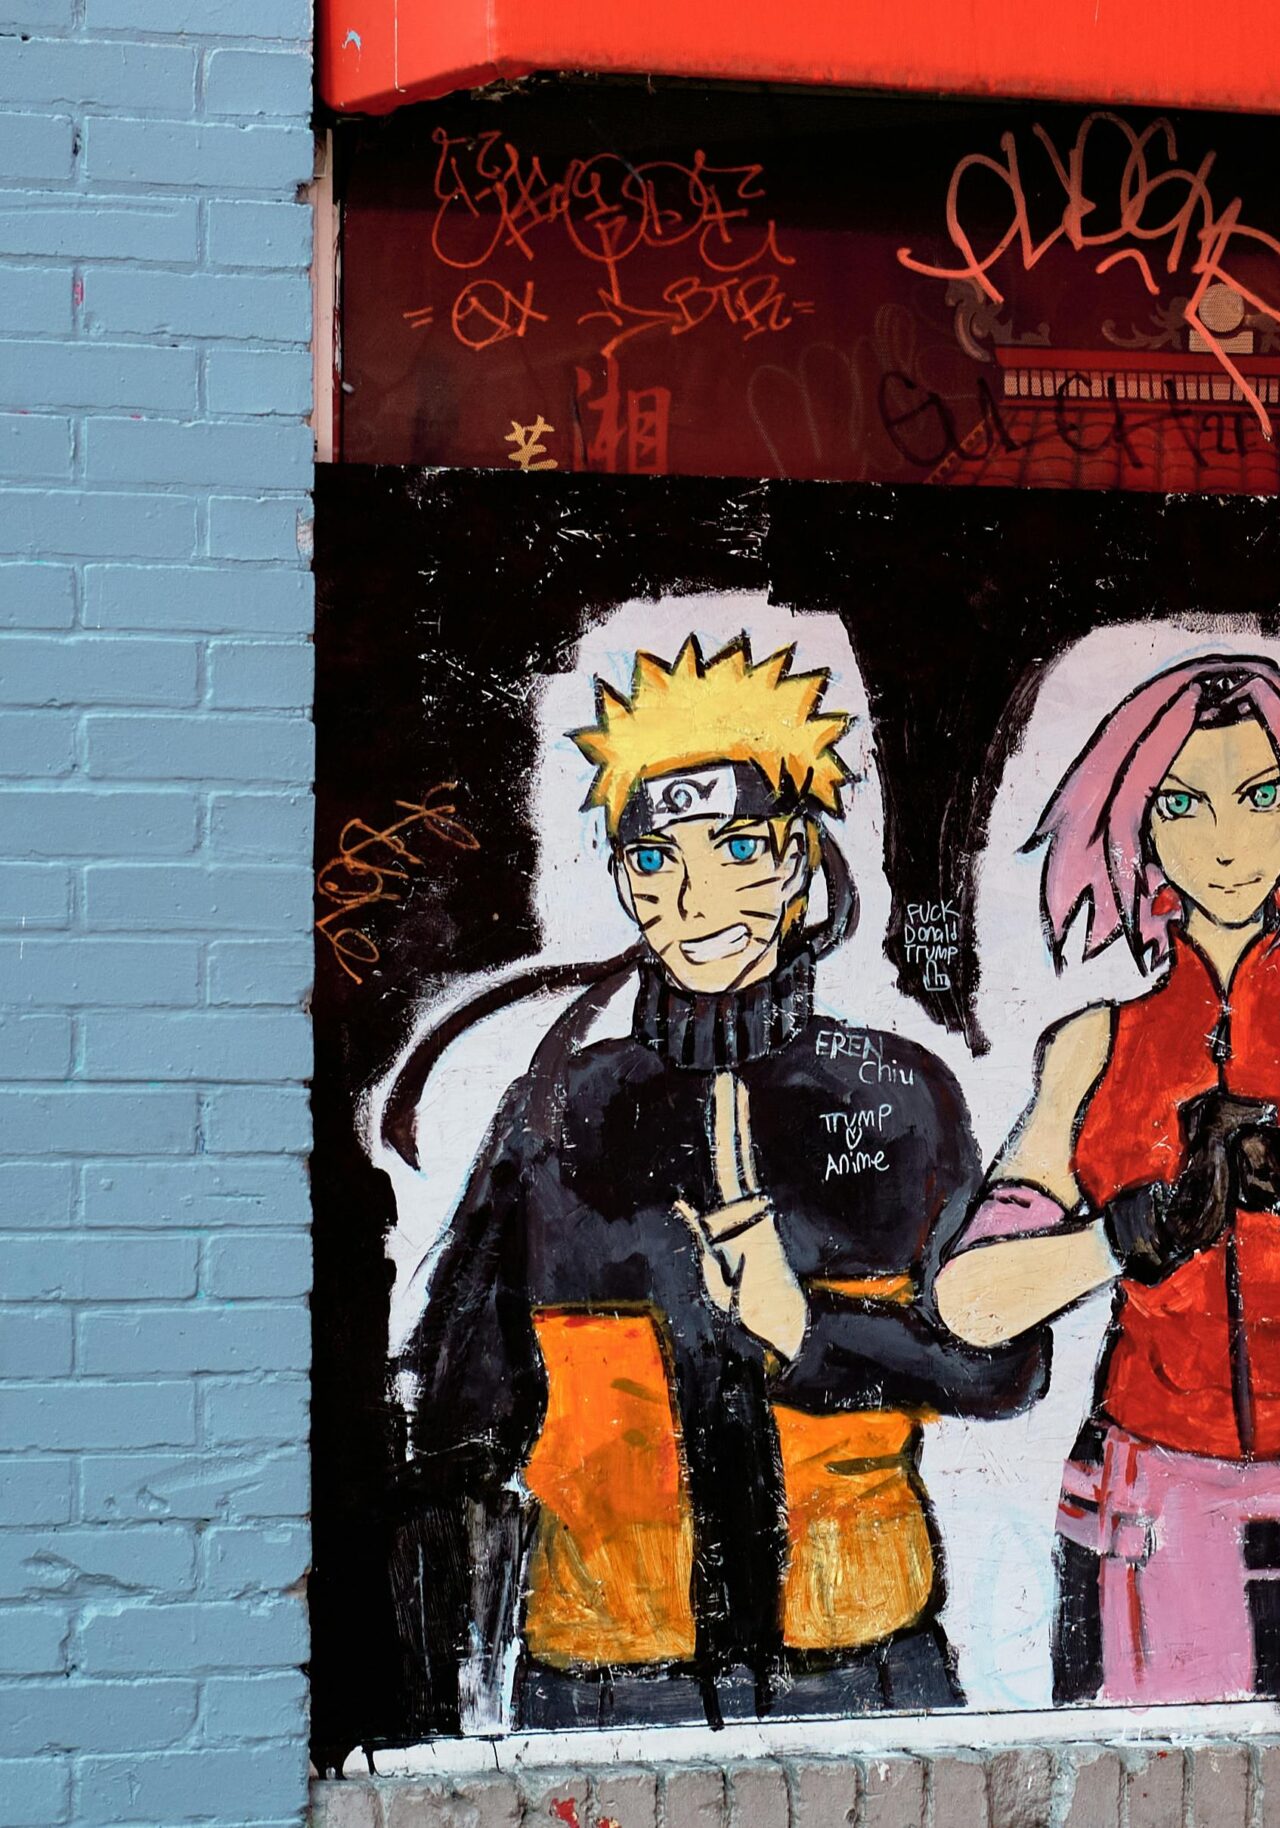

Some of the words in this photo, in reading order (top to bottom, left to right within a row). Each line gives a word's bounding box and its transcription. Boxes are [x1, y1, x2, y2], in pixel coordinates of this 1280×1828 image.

[907, 899, 961, 925] FUCK
[903, 920, 958, 945] Donald
[815, 1029, 884, 1060] EREN
[858, 1056, 915, 1086] Chiu
